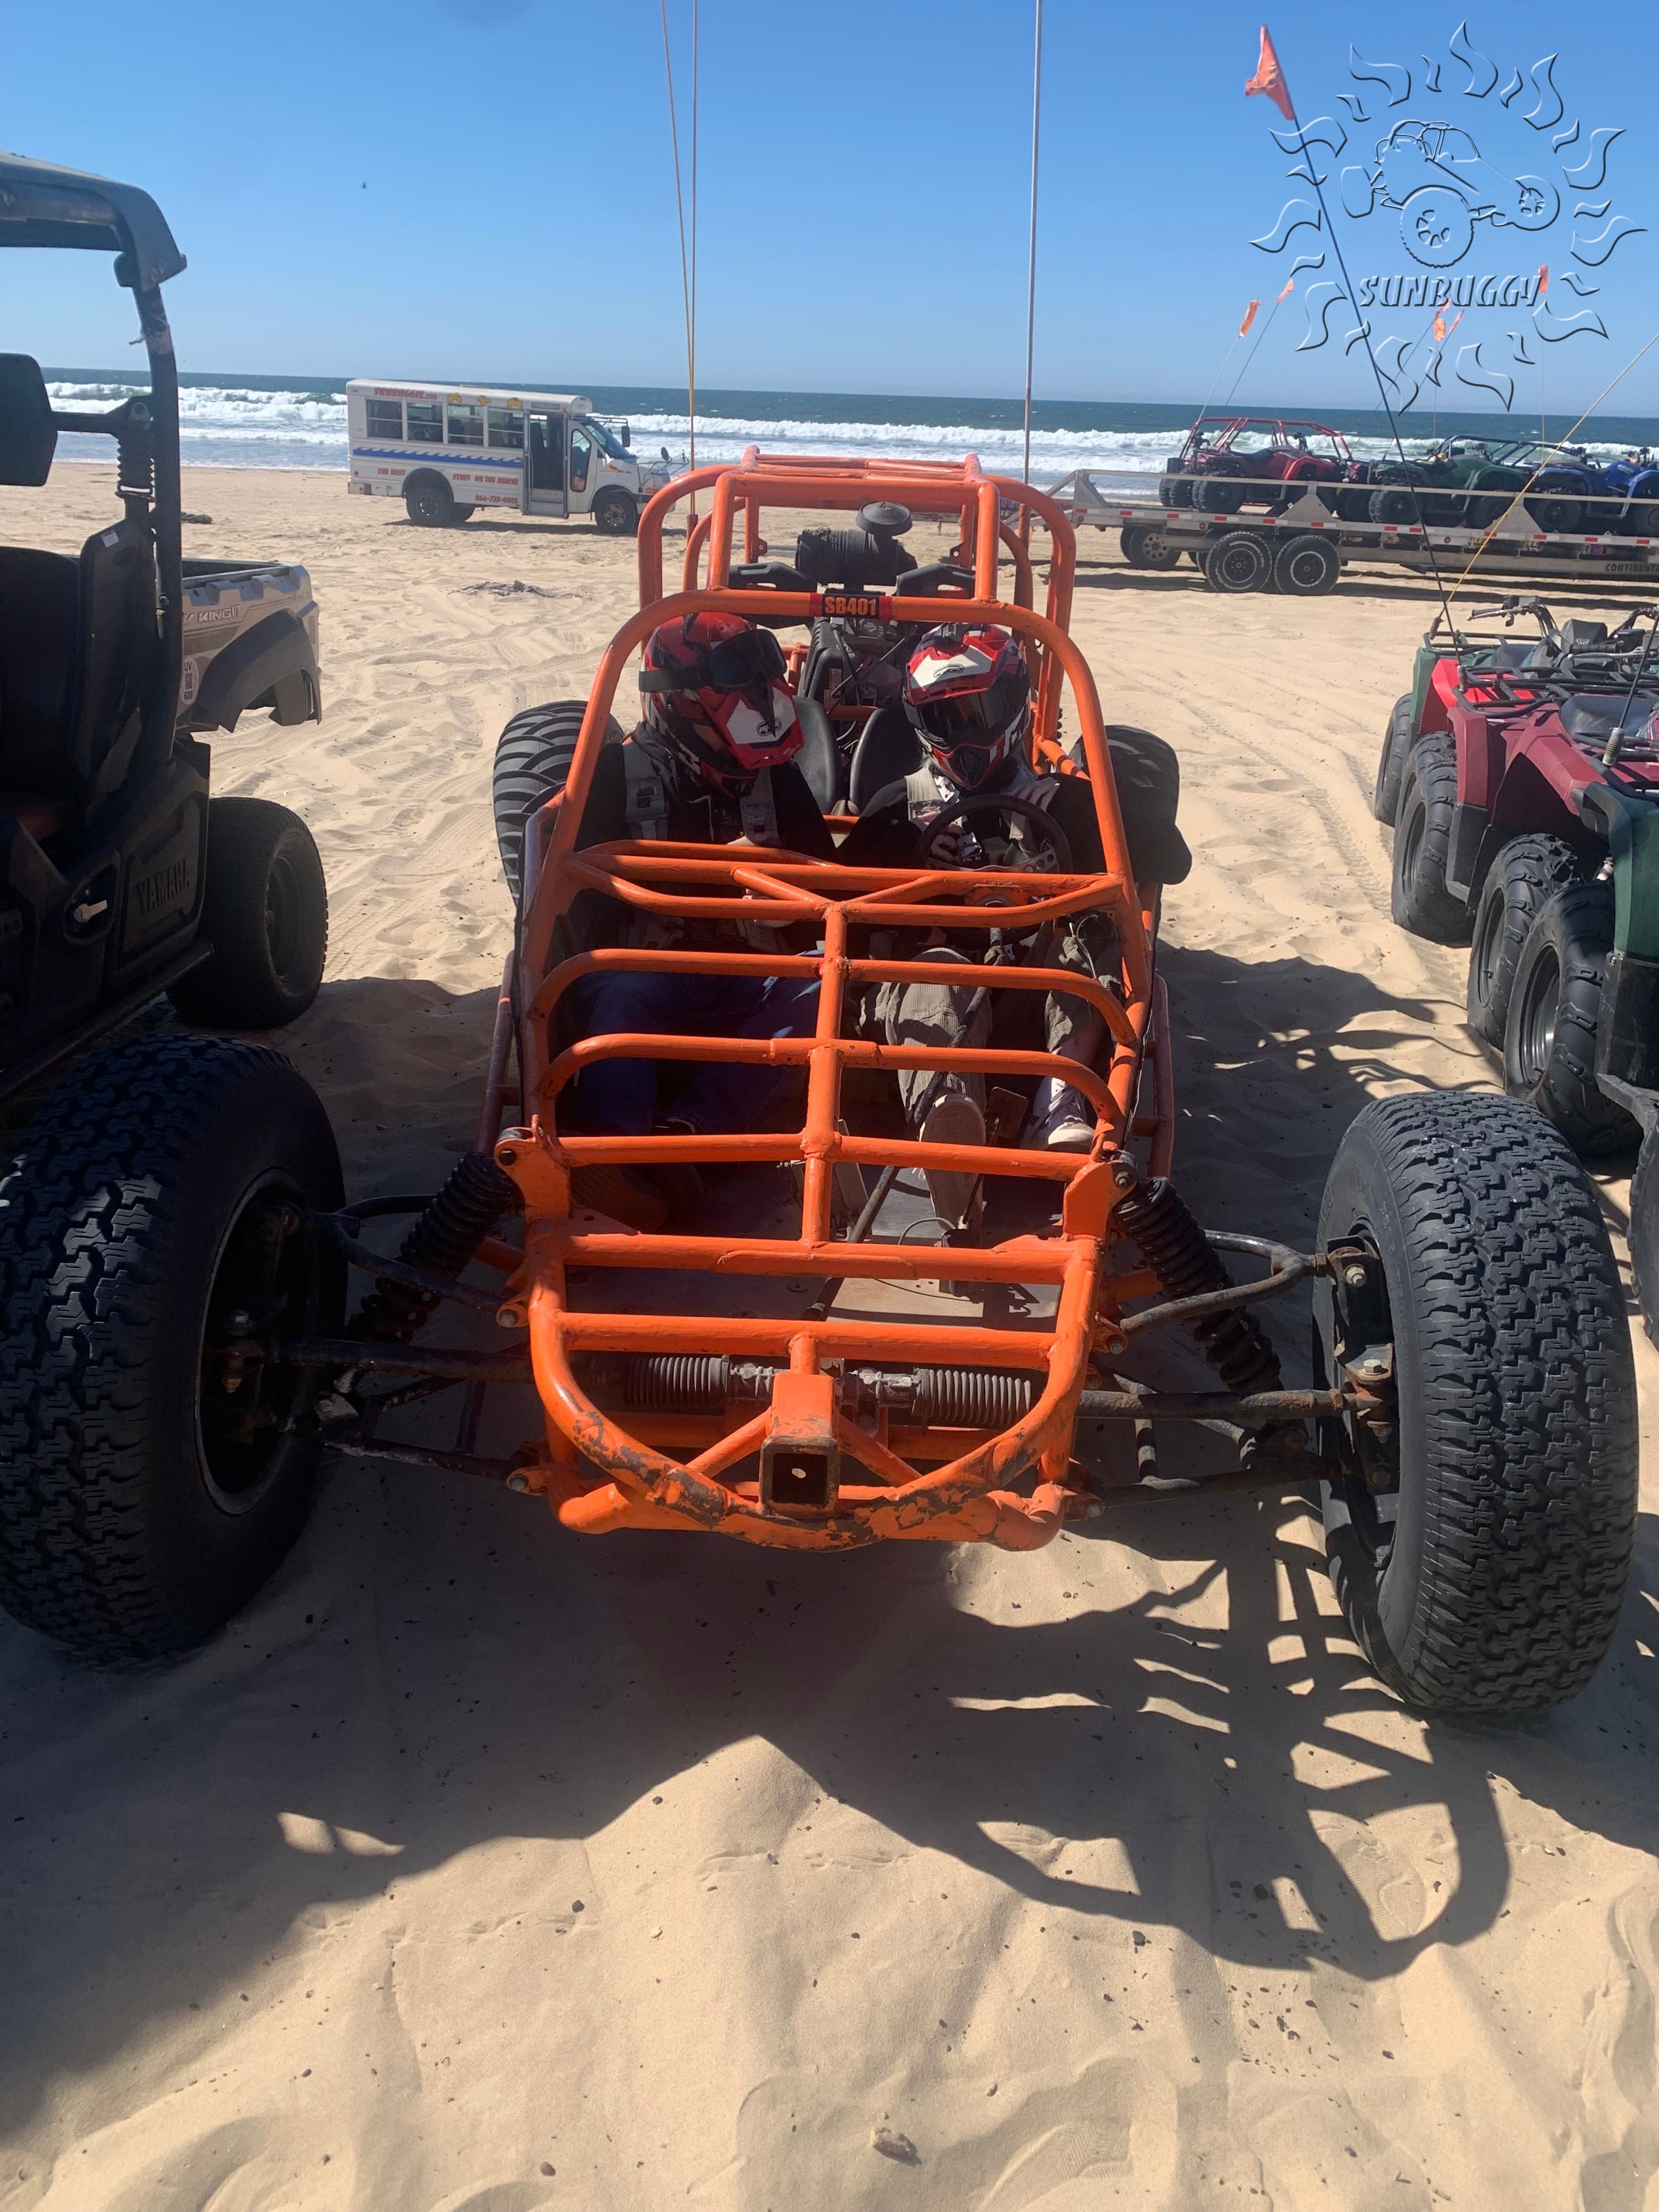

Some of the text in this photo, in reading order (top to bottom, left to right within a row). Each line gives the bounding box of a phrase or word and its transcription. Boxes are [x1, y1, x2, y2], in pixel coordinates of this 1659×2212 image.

[825, 596, 877, 616] SB401
[184, 661, 193, 672] UV
[136, 856, 190, 913] YAMAHA
